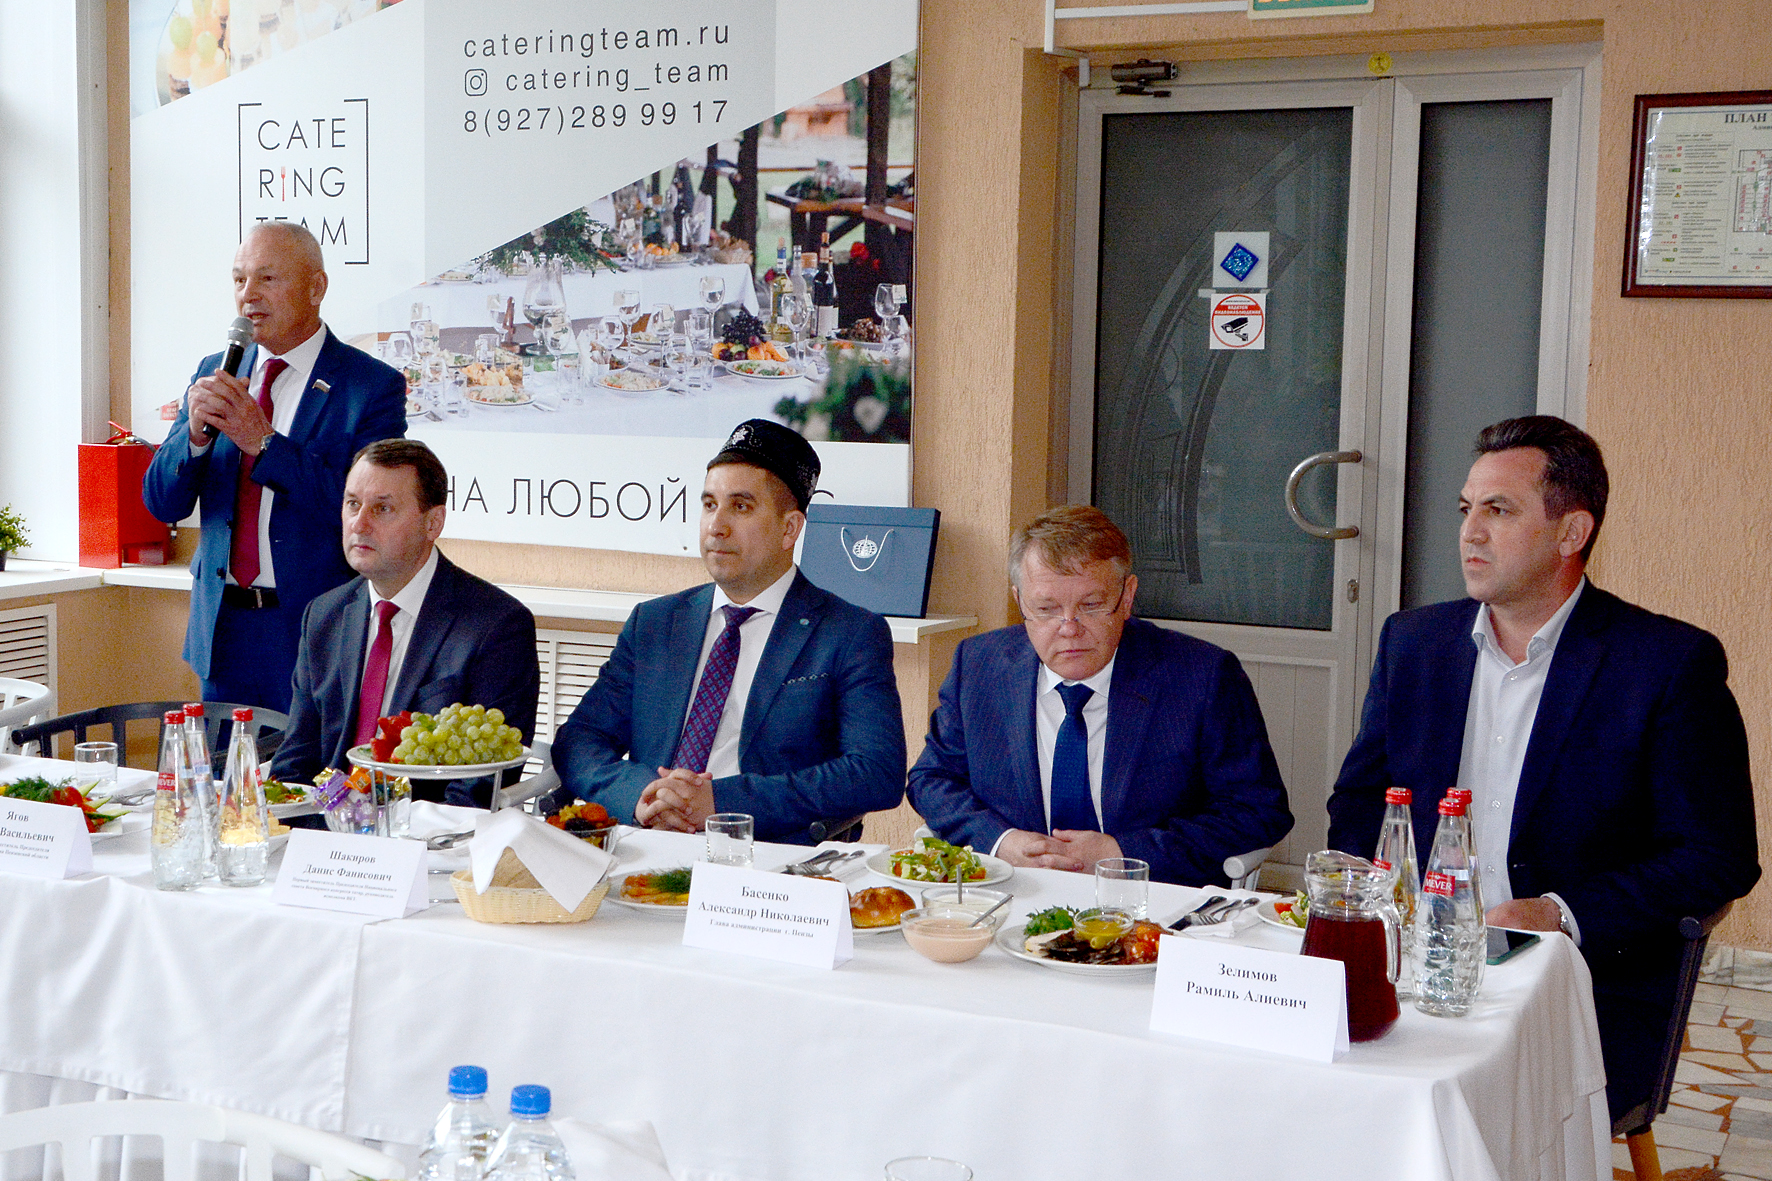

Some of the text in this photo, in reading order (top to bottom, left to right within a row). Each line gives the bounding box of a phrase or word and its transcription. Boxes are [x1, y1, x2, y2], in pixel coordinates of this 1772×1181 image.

[464, 25, 729, 58] cateringteam.ru
[506, 63, 728, 92] catering_team
[464, 100, 728, 137] 8(927)289 99 17
[1725, 112, 1767, 123] ПЛАН
[258, 118, 346, 150] CATE
[507, 477, 687, 523] ЛЮБОЙ
[6, 811, 29, 822] Ягов
[0, 827, 54, 842] Васильевич
[330, 850, 376, 864] Шакиров
[303, 864, 392, 882] Данис Фанисович
[741, 886, 789, 902] Басенко
[699, 901, 830, 926] Александр Николаевич
[1218, 963, 1277, 983] Зелимов
[1186, 981, 1307, 1010] Рамиль Алиевич
